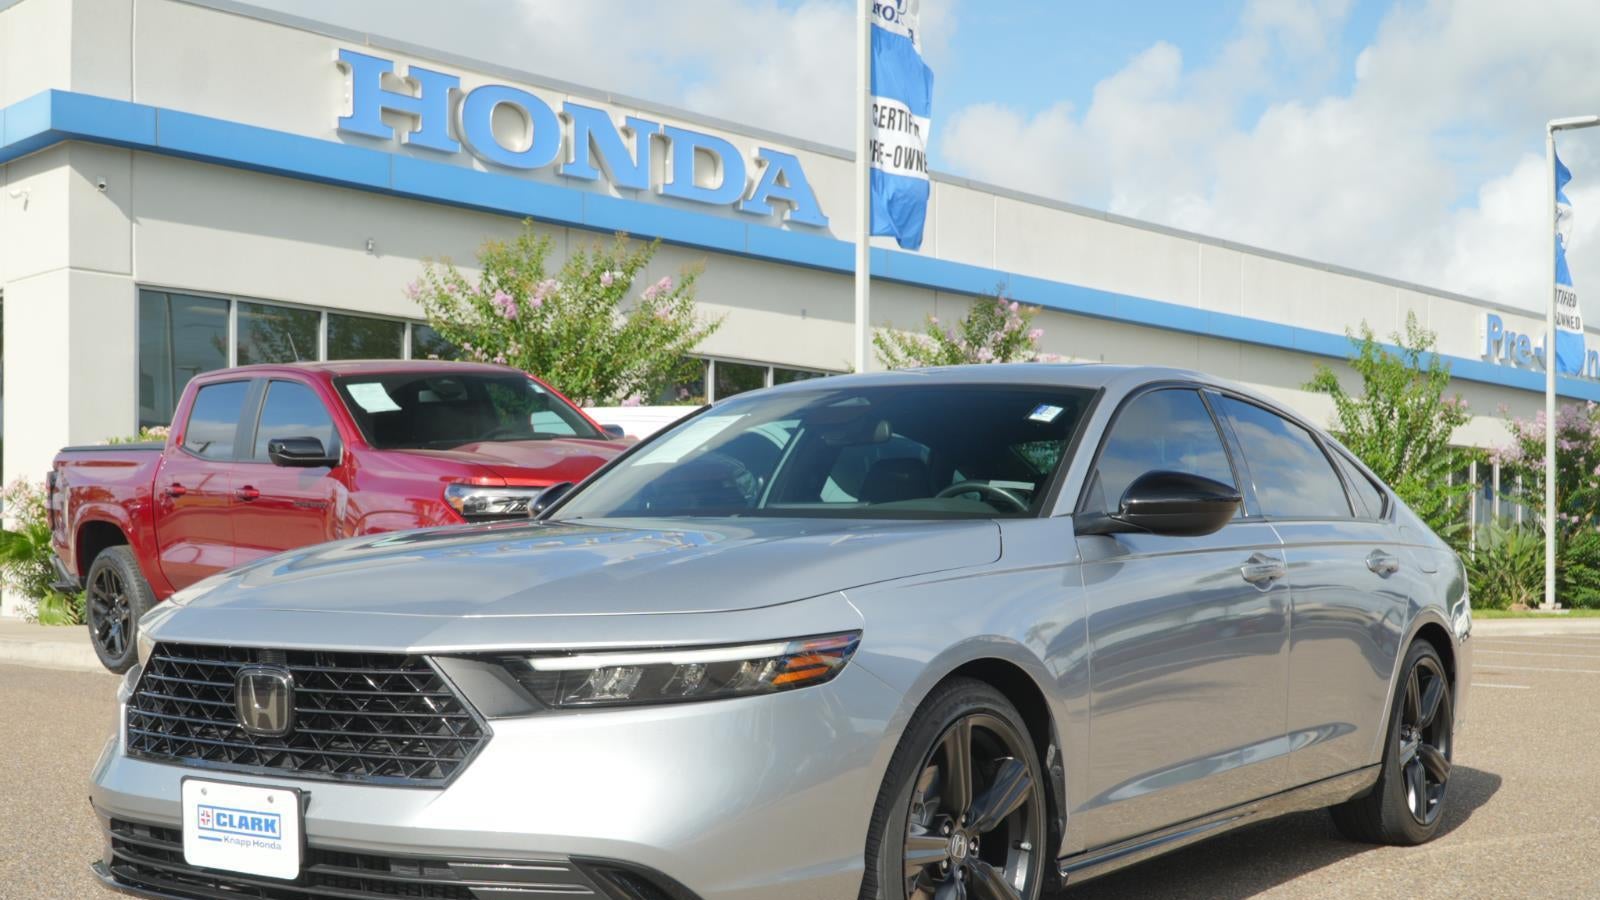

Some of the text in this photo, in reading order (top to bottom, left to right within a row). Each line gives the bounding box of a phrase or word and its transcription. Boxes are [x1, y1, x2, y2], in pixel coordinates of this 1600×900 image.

[872, 103, 920, 136] CERTIF
[337, 47, 829, 228] HONDA
[869, 139, 929, 174] RE-OWNE
[1554, 288, 1577, 308] TIFIED
[216, 813, 276, 833] CLARK
[223, 836, 281, 850] Knapp Honda
